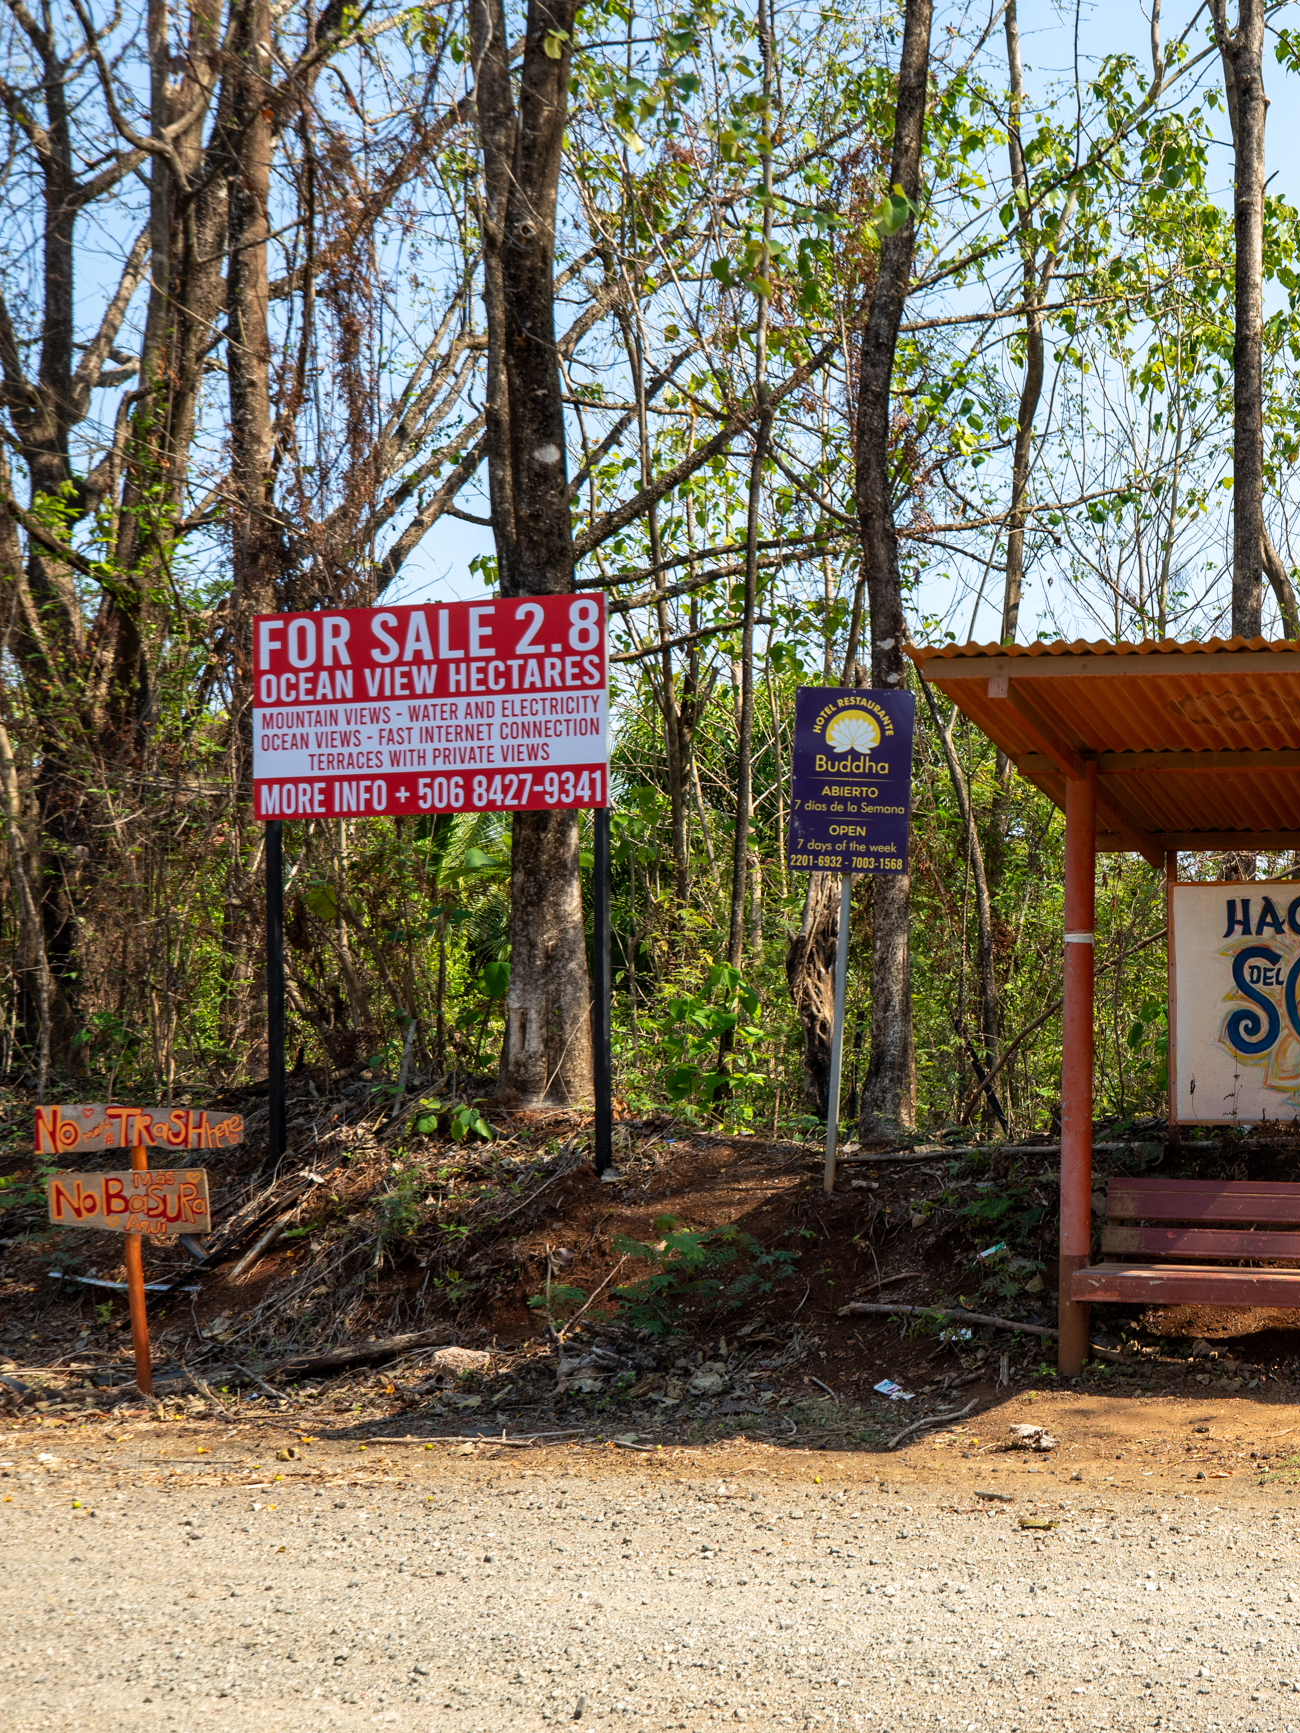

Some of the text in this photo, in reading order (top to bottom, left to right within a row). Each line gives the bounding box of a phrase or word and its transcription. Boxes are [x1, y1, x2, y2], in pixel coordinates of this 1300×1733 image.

[259, 599, 600, 670] FOR SALE 2.8
[260, 655, 600, 702] OCEAN VIEW HECTARES
[262, 709, 339, 730] MOUNTAIN
[344, 706, 391, 726] VIEWS
[408, 703, 457, 722] WATER
[464, 701, 495, 720] AND
[502, 695, 600, 718] ELECTRICITY
[812, 696, 895, 737] HOTEL RESTAURANTE
[261, 732, 309, 751] OCEAN
[315, 729, 361, 749] VIEWS
[378, 727, 413, 746] FAST
[419, 723, 494, 745] INTERNET
[500, 717, 600, 740] CONNECTION
[308, 742, 550, 772] TERRACES WITH PRIVATE VIEWS
[815, 754, 889, 774] Buddha
[260, 782, 326, 815] MORE
[333, 779, 387, 812] INFO
[418, 776, 465, 809] 506
[473, 770, 602, 808] 8427-9341
[821, 786, 879, 798] ABIERTO
[794, 799, 905, 815] 7 días de la Semana
[829, 825, 866, 837] OPEN
[797, 838, 897, 853] 7 days of the week
[790, 854, 842, 868] 2201-6932
[851, 857, 903, 870] 7003-1568
[1248, 964, 1285, 987] DEL
[125, 1213, 168, 1234] Aquí
